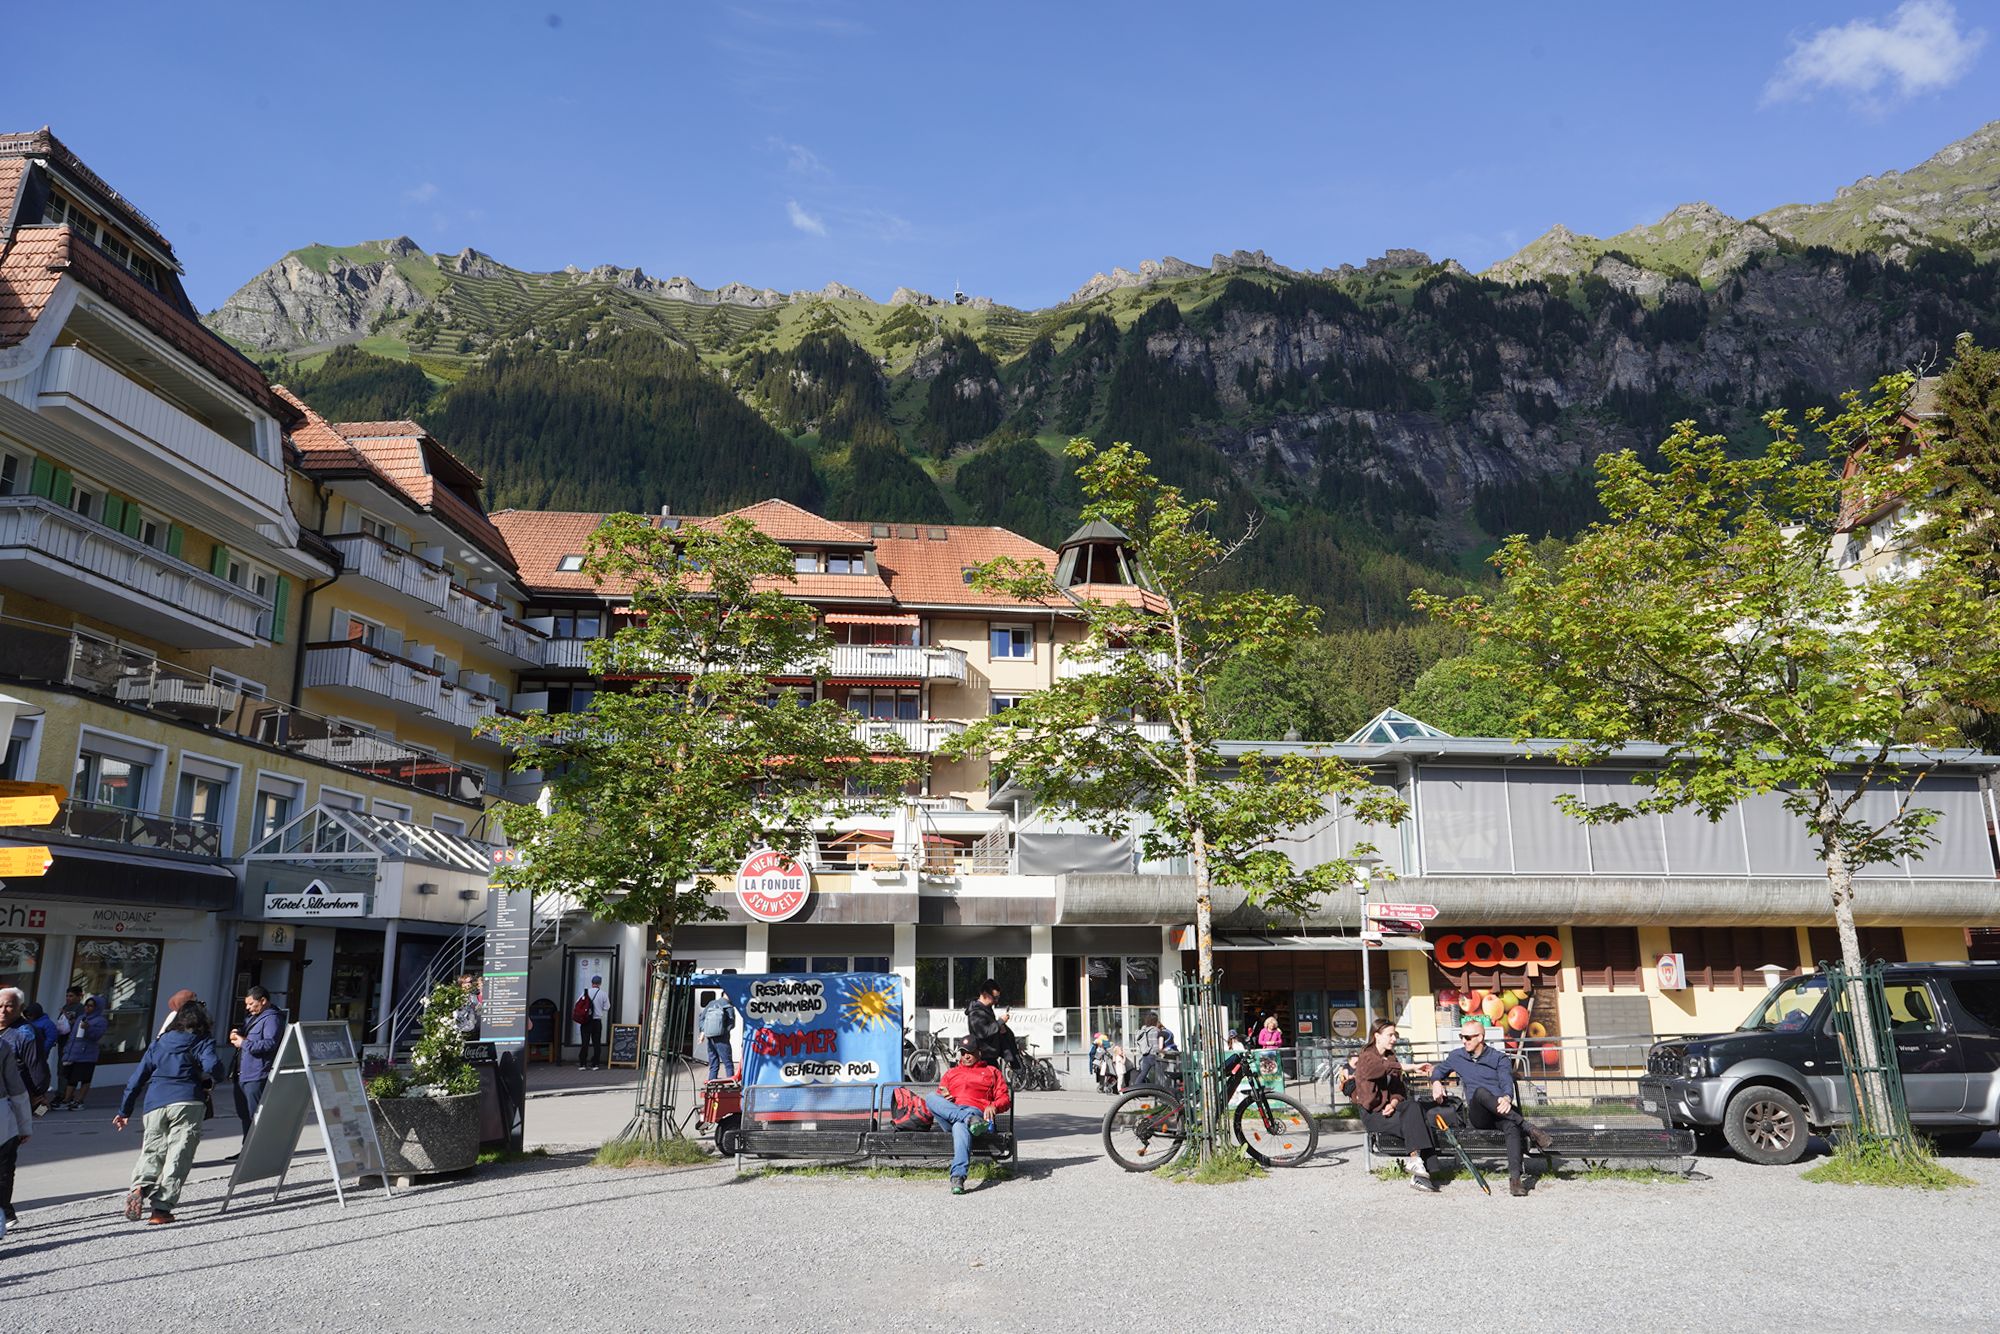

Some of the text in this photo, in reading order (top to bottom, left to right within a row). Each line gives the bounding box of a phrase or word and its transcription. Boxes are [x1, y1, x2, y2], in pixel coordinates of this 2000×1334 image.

[751, 856, 795, 874] WENG
[745, 878, 801, 890] LA FONDUE
[267, 896, 359, 910] Hotel Silberhorn
[749, 893, 797, 913] SCHWEIZ
[93, 909, 153, 922] MONDAINE
[1435, 934, 1563, 977] coop
[755, 983, 823, 997] RESTAURANT
[750, 998, 822, 1014] SCHWIMMBAD
[752, 1027, 837, 1057] SOMMER
[784, 1062, 876, 1077] GEHEIZTER POOL
